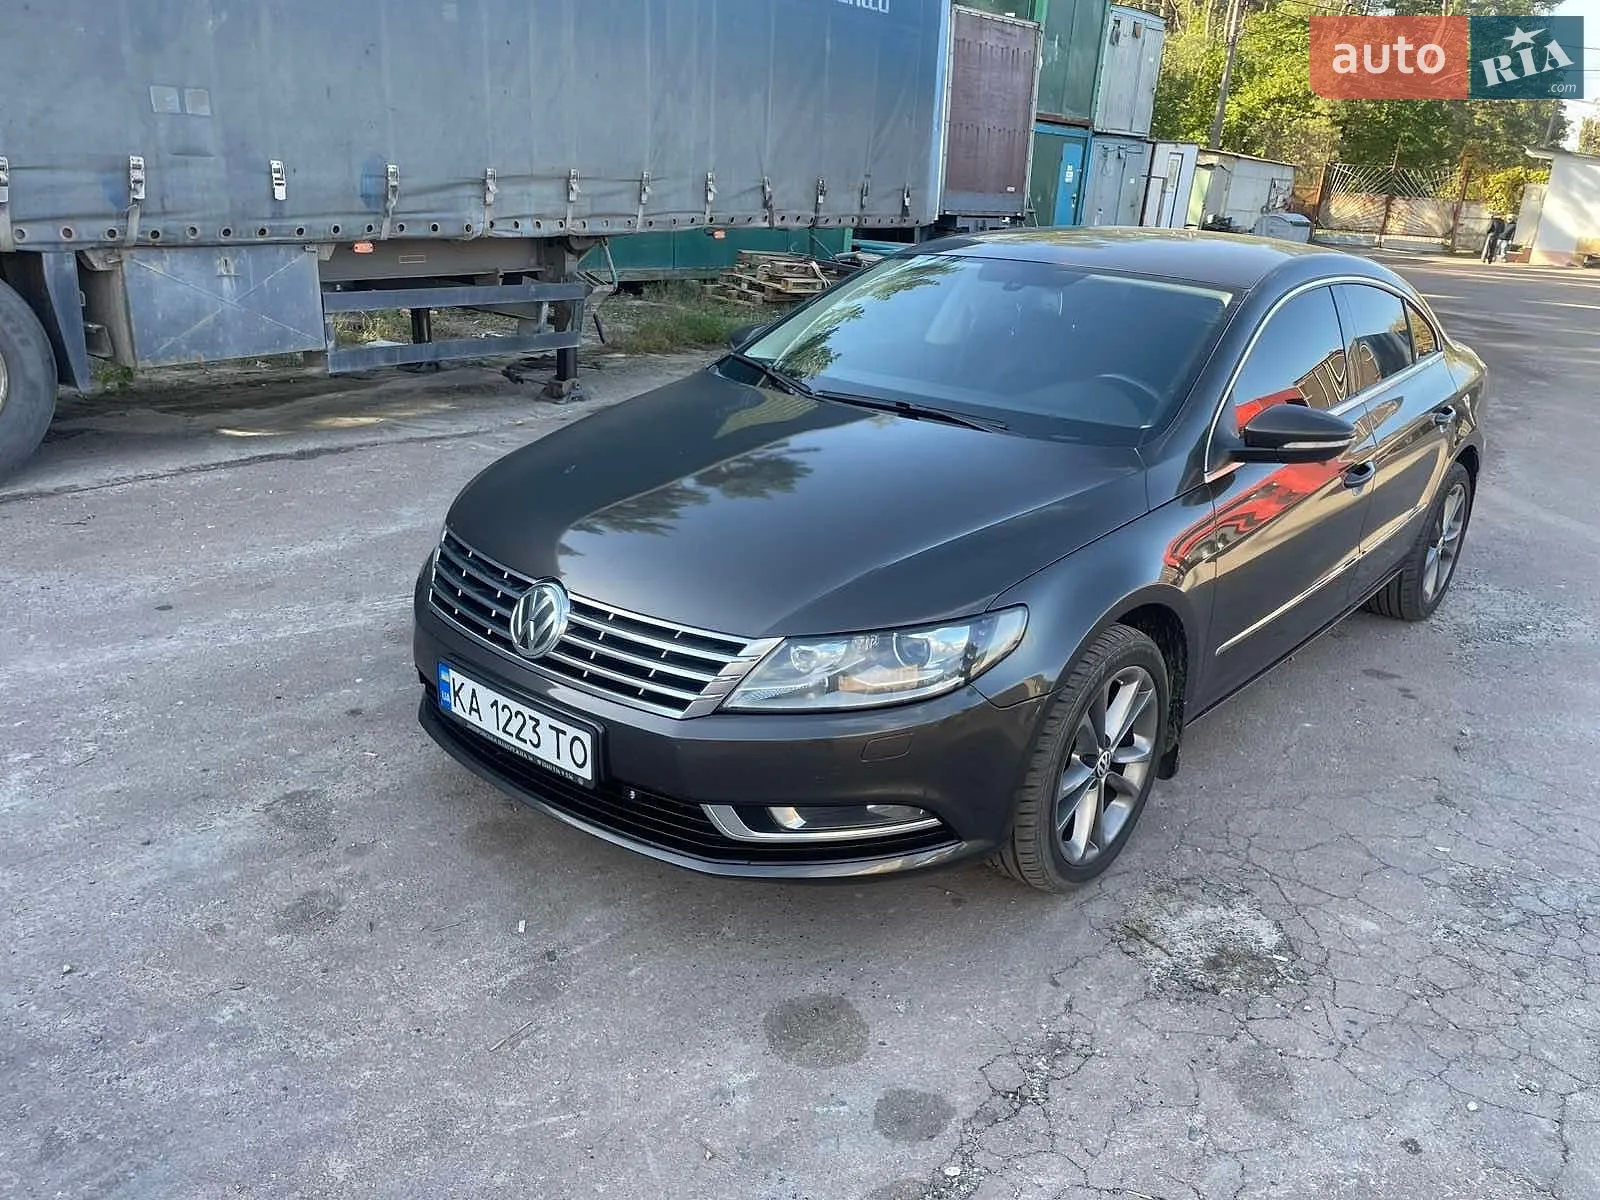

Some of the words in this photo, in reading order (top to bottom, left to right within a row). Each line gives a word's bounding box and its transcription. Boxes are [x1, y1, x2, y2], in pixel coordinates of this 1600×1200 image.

[451, 677, 483, 722] KA
[490, 699, 541, 749] 1223
[548, 724, 588, 769] TO
